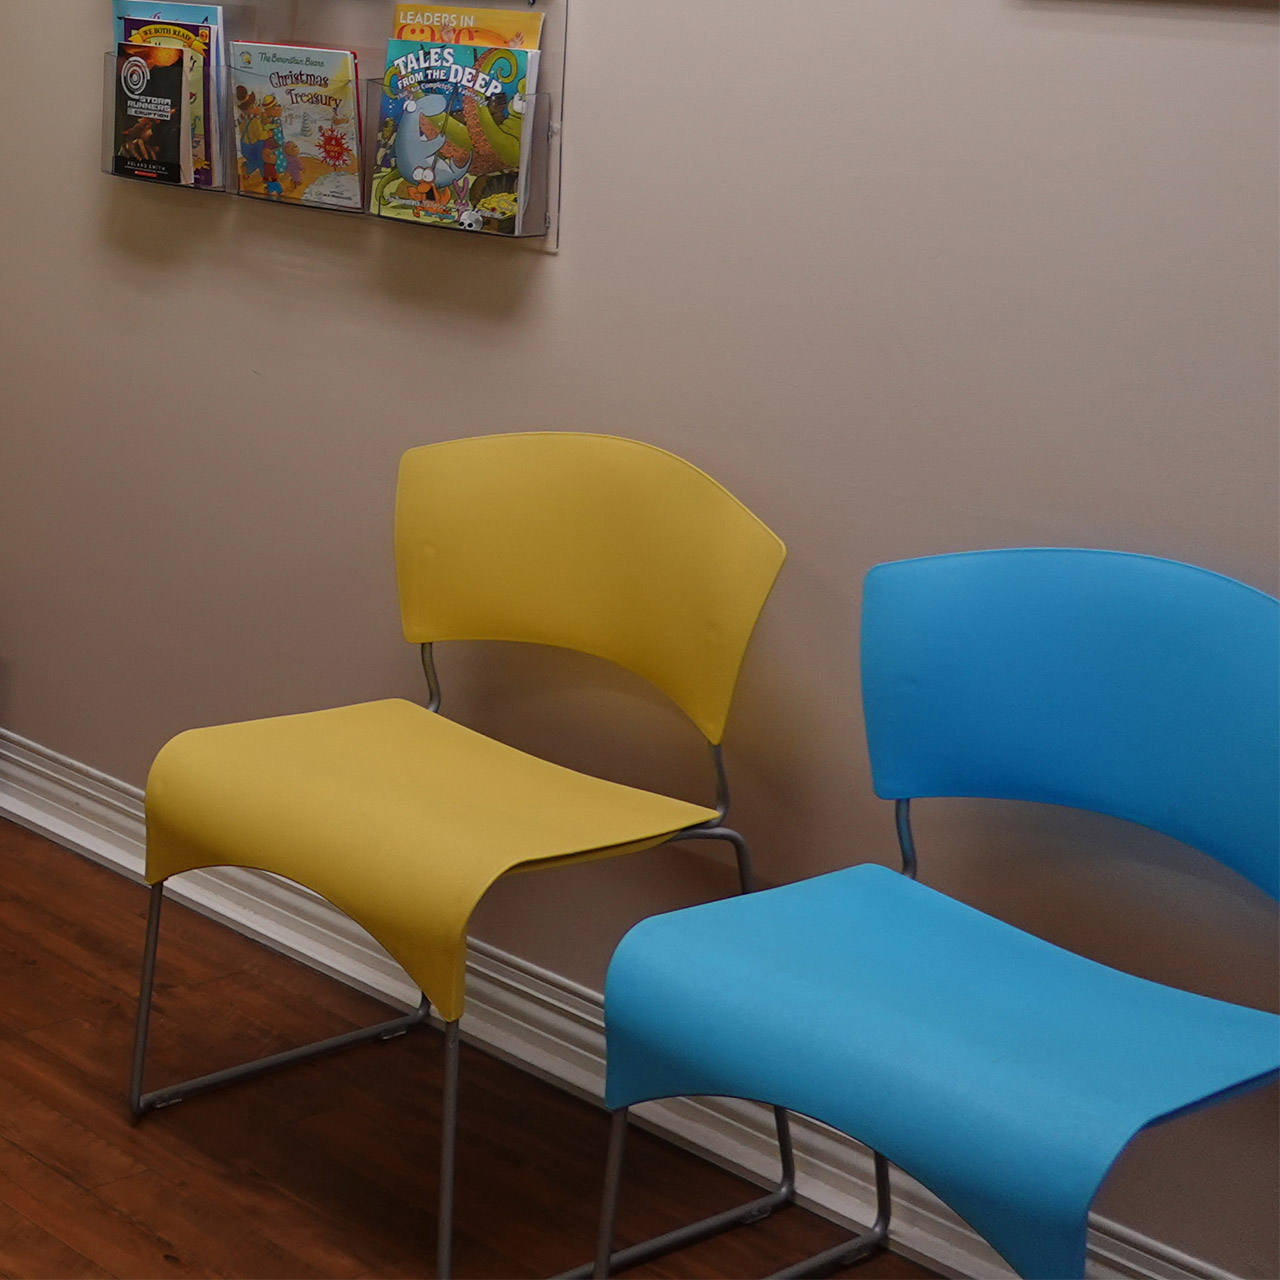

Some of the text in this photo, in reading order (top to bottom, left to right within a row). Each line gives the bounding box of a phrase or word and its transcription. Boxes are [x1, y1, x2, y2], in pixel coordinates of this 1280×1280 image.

[399, 11, 475, 27] LEADERS IN
[142, 28, 153, 36] WE
[153, 27, 171, 35] BOTH
[258, 52, 271, 63] The
[304, 56, 325, 67] Bears
[393, 47, 455, 76] TALES
[269, 70, 329, 89] Christmas
[397, 64, 503, 97] FROM THE DEEP
[127, 100, 171, 112] RUNNERS
[139, 96, 172, 106] STORM
[285, 88, 343, 117] Treasury
[134, 109, 170, 119] ERUPTION
